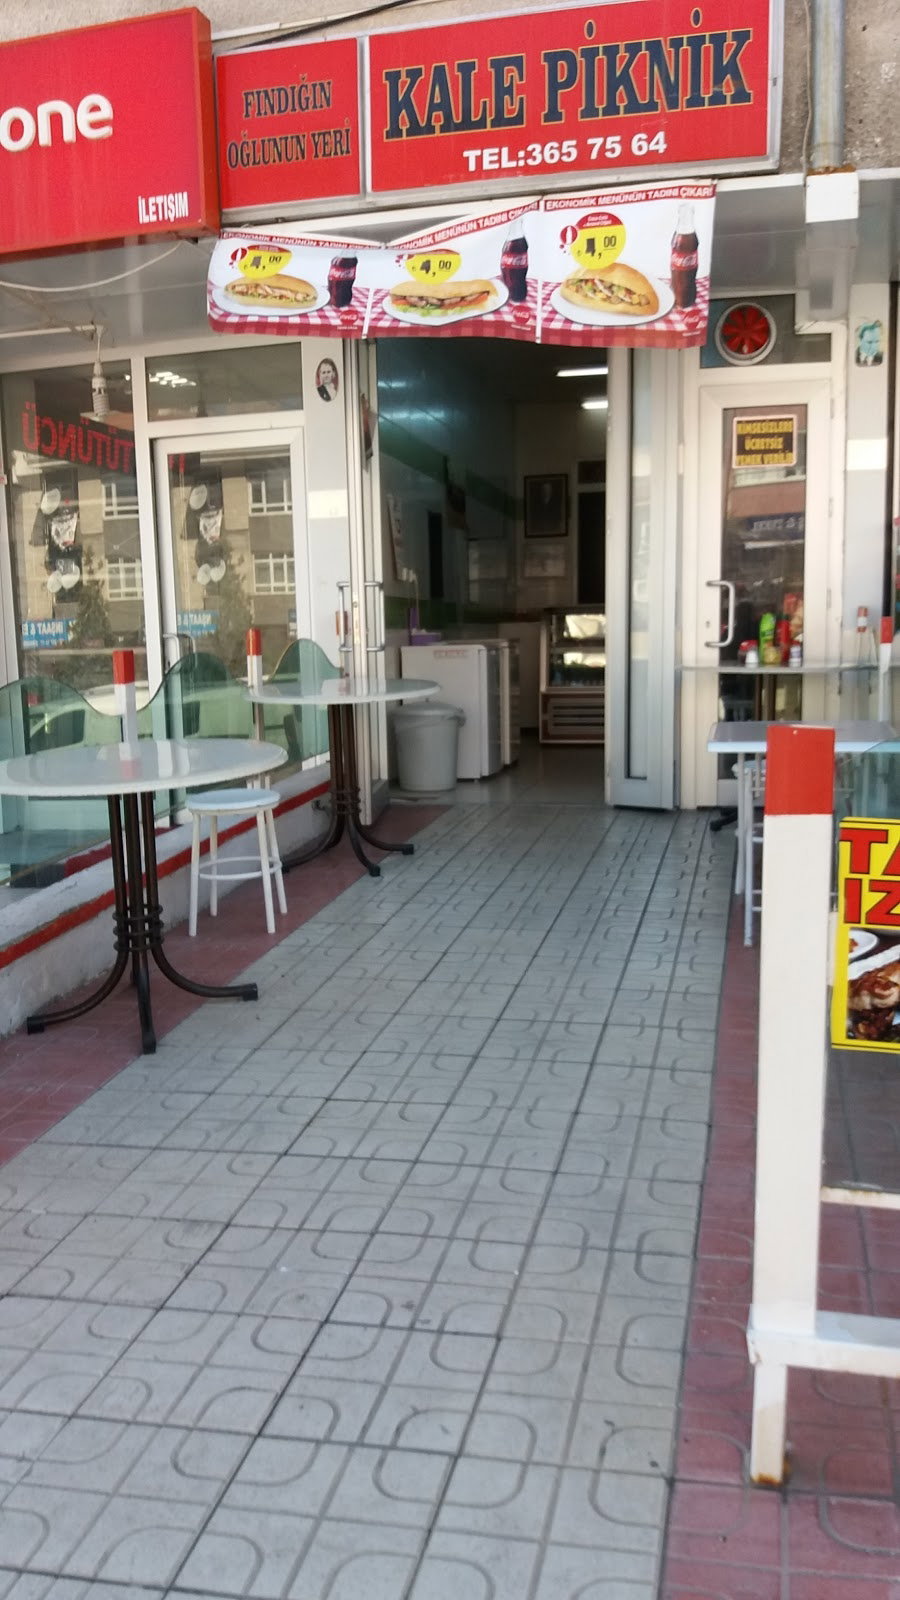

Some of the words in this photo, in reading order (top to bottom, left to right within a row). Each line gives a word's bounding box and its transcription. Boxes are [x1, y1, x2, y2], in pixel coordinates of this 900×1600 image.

[242, 75, 333, 119] FINDIĞIN
[384, 53, 527, 141] KALE
[541, 7, 754, 125] PİKNİK
[0, 93, 114, 153] one
[227, 128, 307, 169] OĞLUNUN
[311, 119, 352, 159] YERİ
[587, 136, 624, 161] 75
[631, 131, 667, 156] 64
[547, 196, 596, 210] EKONOMİK
[597, 192, 646, 206] MENÜNÜN
[647, 188, 679, 200] TADINI
[680, 186, 713, 199] ÇIKAR!
